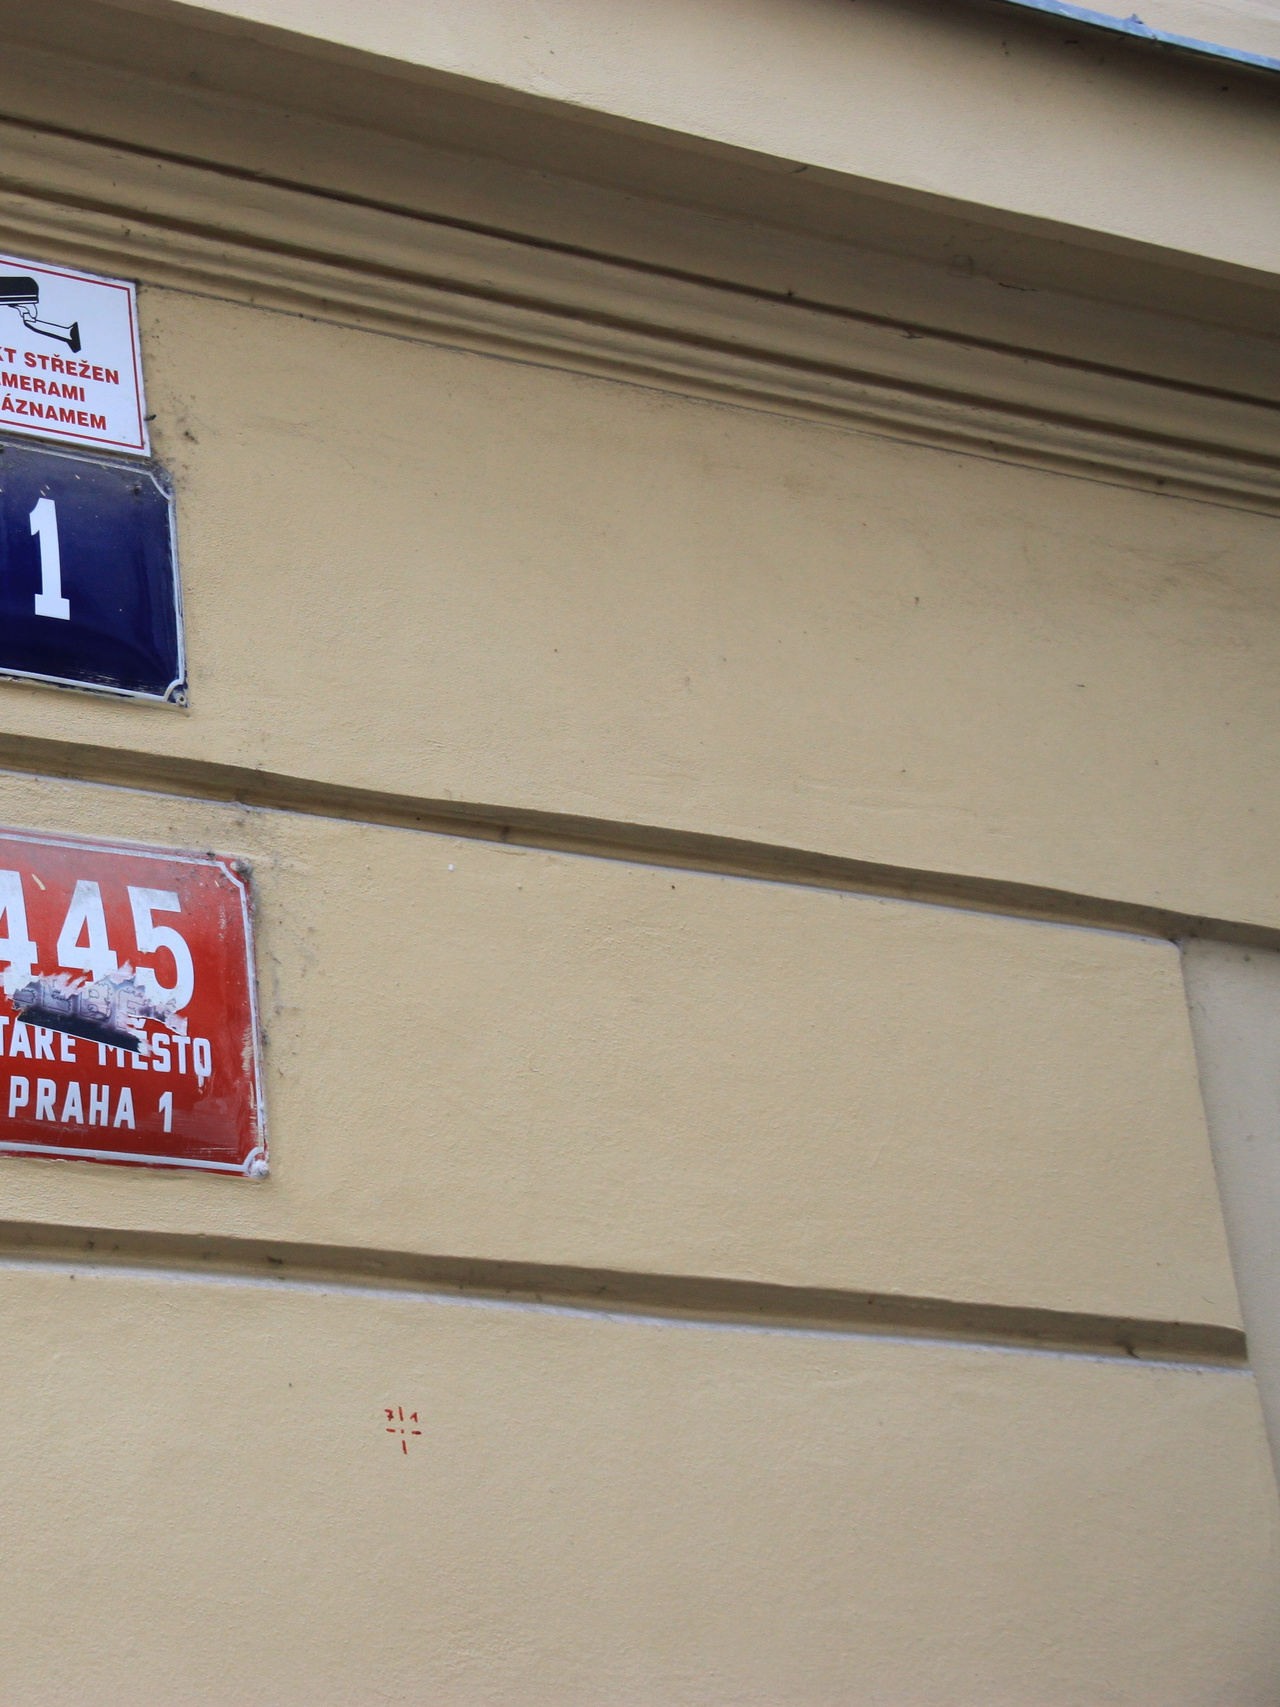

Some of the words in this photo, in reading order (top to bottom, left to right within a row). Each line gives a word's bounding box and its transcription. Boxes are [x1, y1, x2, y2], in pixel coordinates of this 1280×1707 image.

[24, 352, 119, 384] STŘEŽEN
[29, 497, 70, 620] 1
[8, 1075, 136, 1130] PRAHA
[158, 1091, 173, 1133] 1
